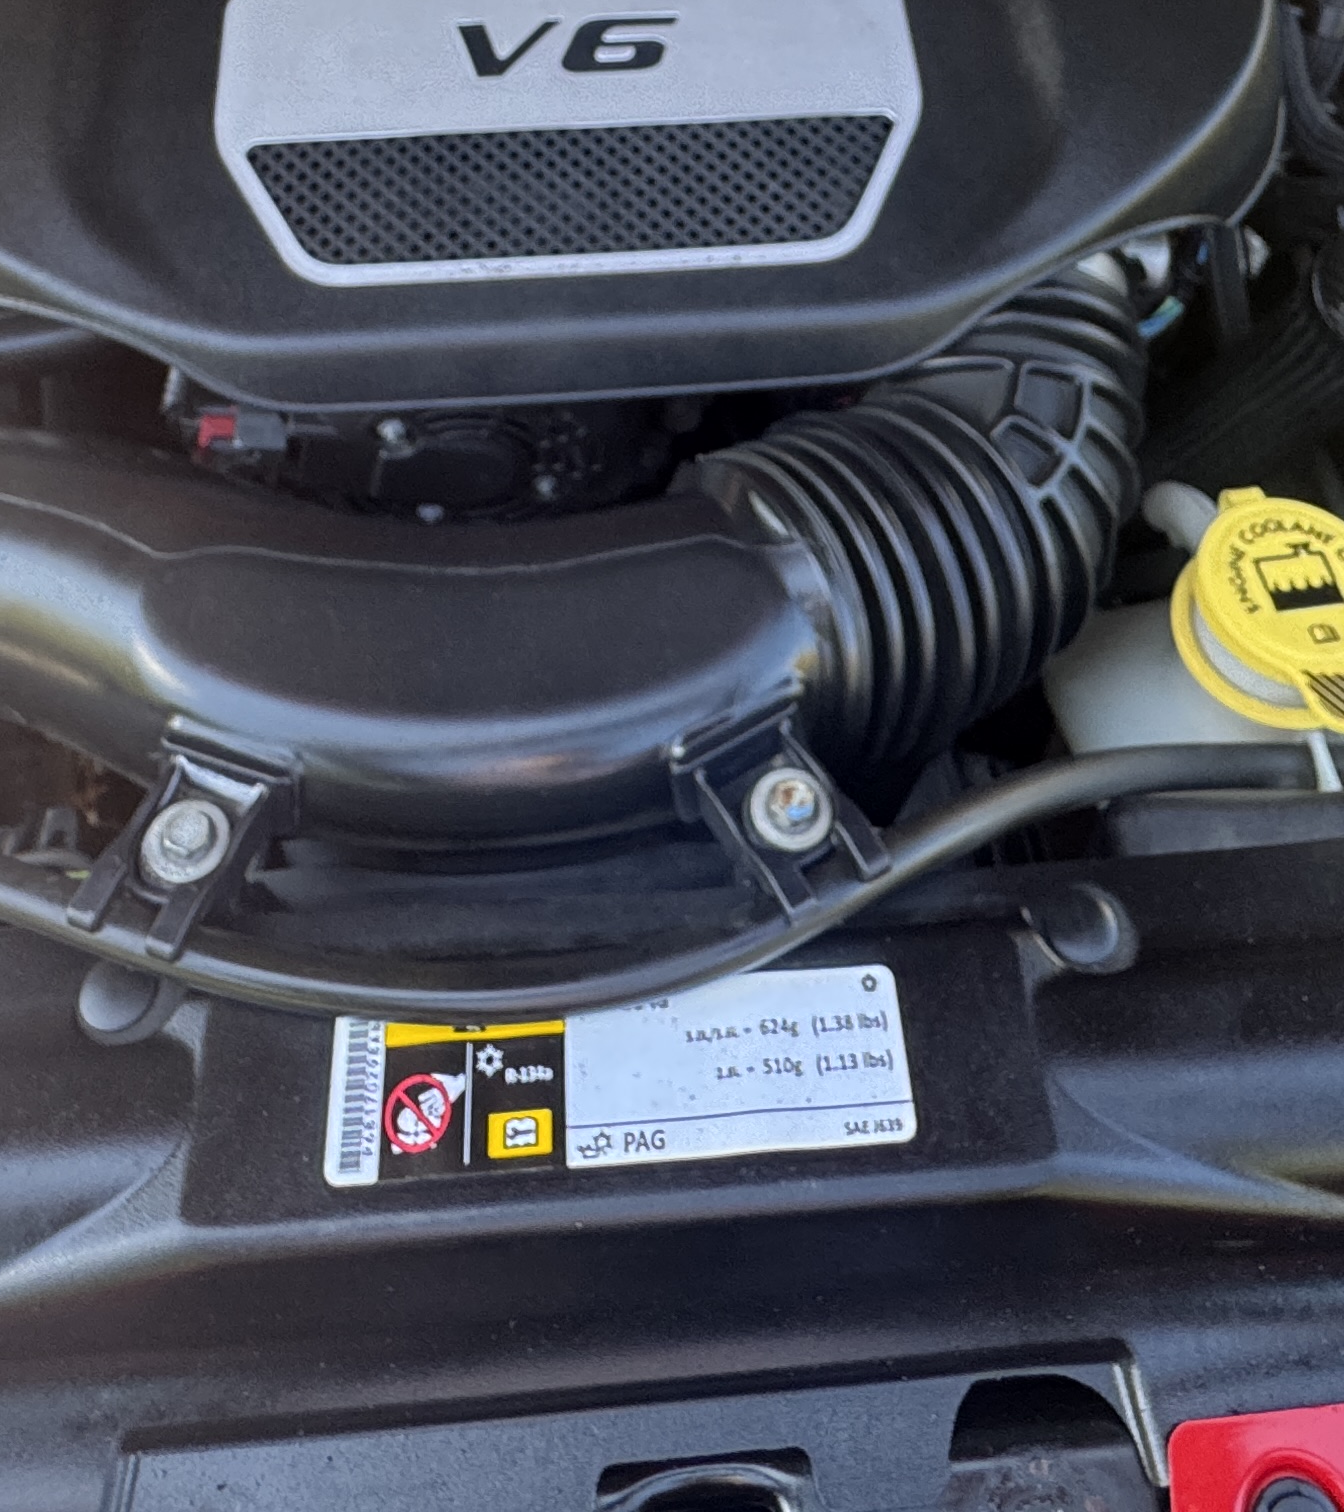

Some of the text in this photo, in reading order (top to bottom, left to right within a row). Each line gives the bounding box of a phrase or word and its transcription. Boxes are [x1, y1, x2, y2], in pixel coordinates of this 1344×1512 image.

[456, 10, 680, 78] V6
[1238, 518, 1336, 545] COOLANT
[623, 1129, 666, 1153] PAG
